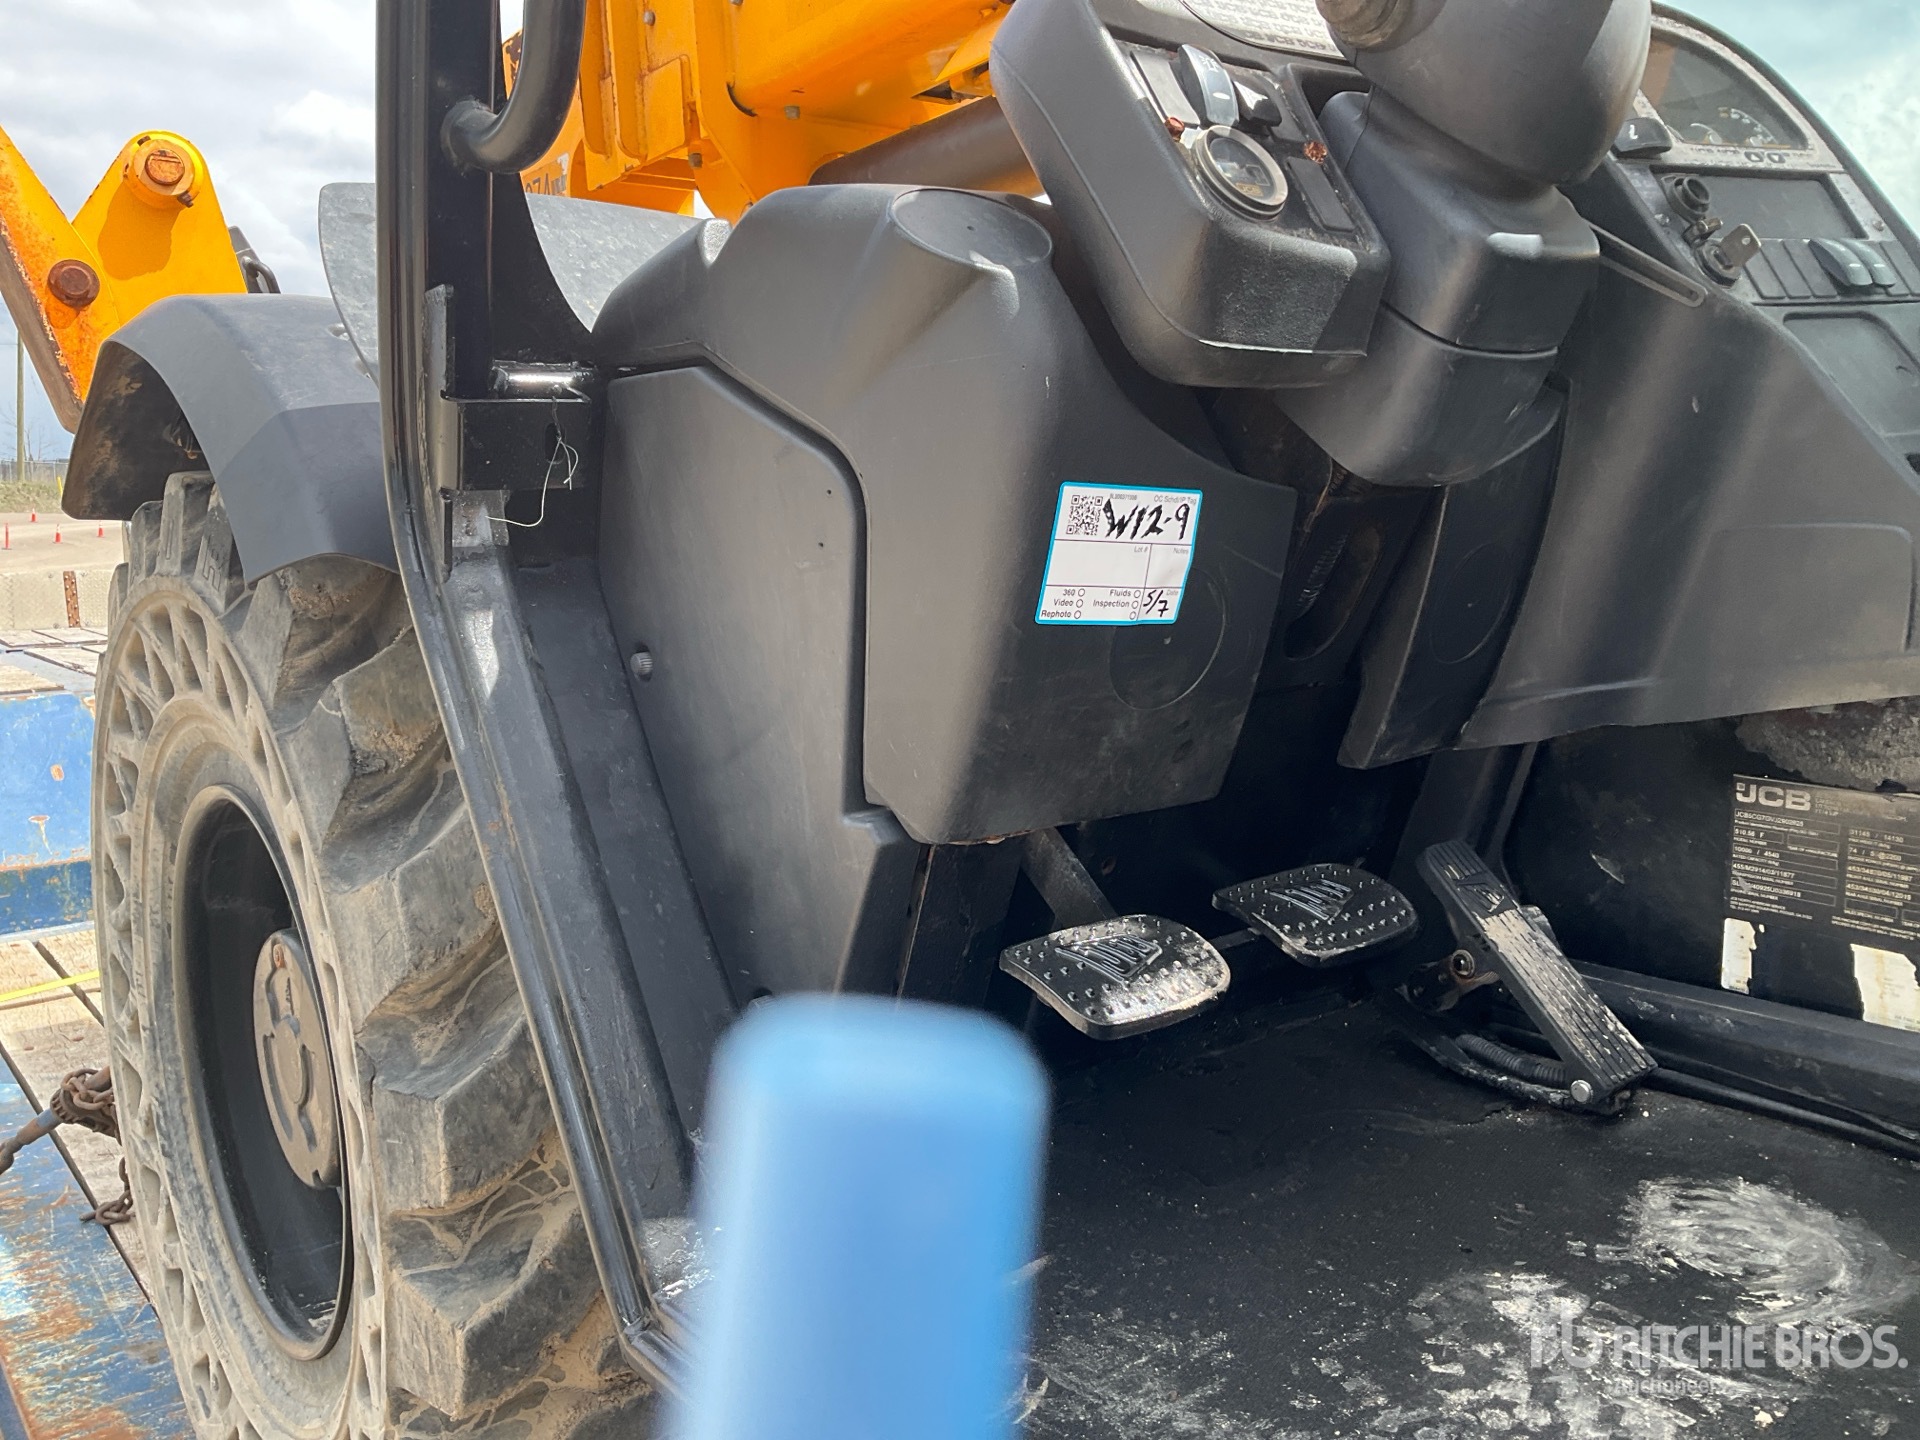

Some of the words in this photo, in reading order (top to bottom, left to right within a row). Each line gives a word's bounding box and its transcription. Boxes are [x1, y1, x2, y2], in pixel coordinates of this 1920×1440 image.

[1103, 498, 1191, 540] W12-9
[1053, 599, 1074, 607] Video
[1092, 600, 1130, 609] Inspection
[1041, 610, 1072, 619] Rephoto
[1735, 782, 1811, 811] JCB
